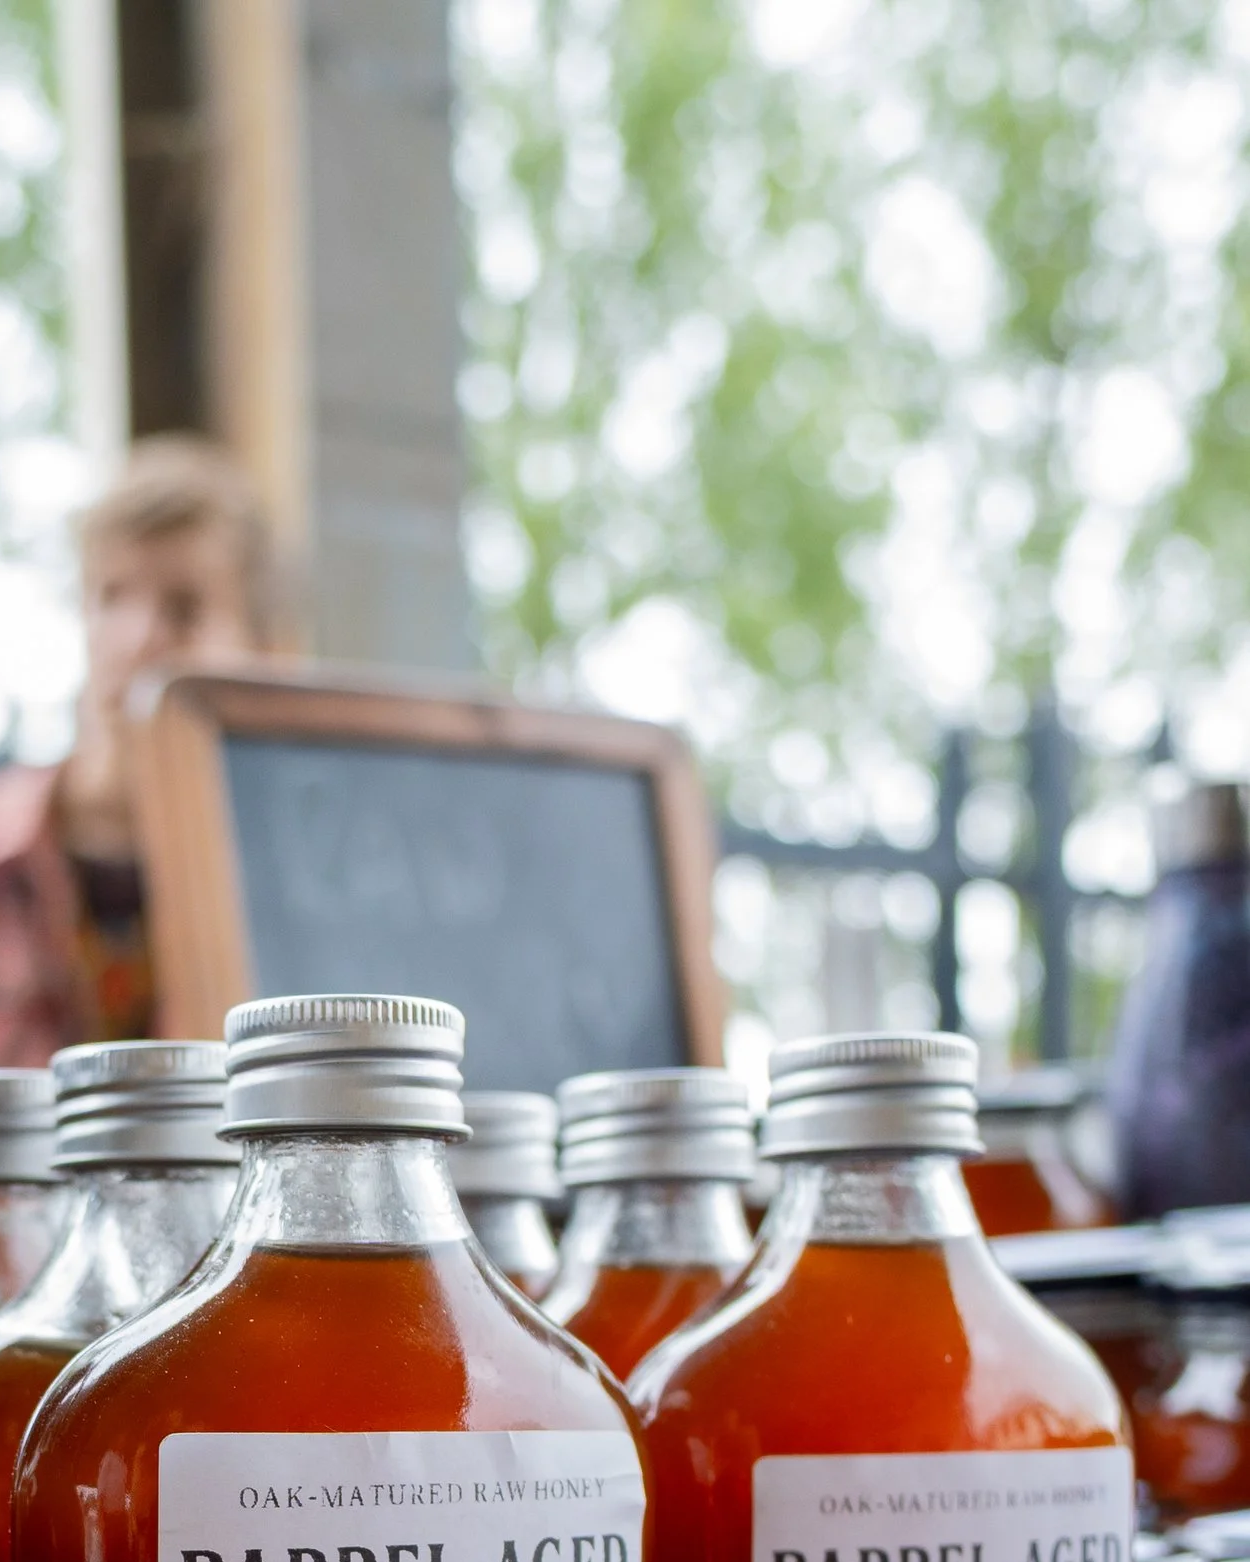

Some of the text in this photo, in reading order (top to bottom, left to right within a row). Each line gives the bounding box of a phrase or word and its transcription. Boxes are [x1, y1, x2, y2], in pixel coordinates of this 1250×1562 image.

[238, 1477, 607, 1510] OAK-MATURED RAW HONEY
